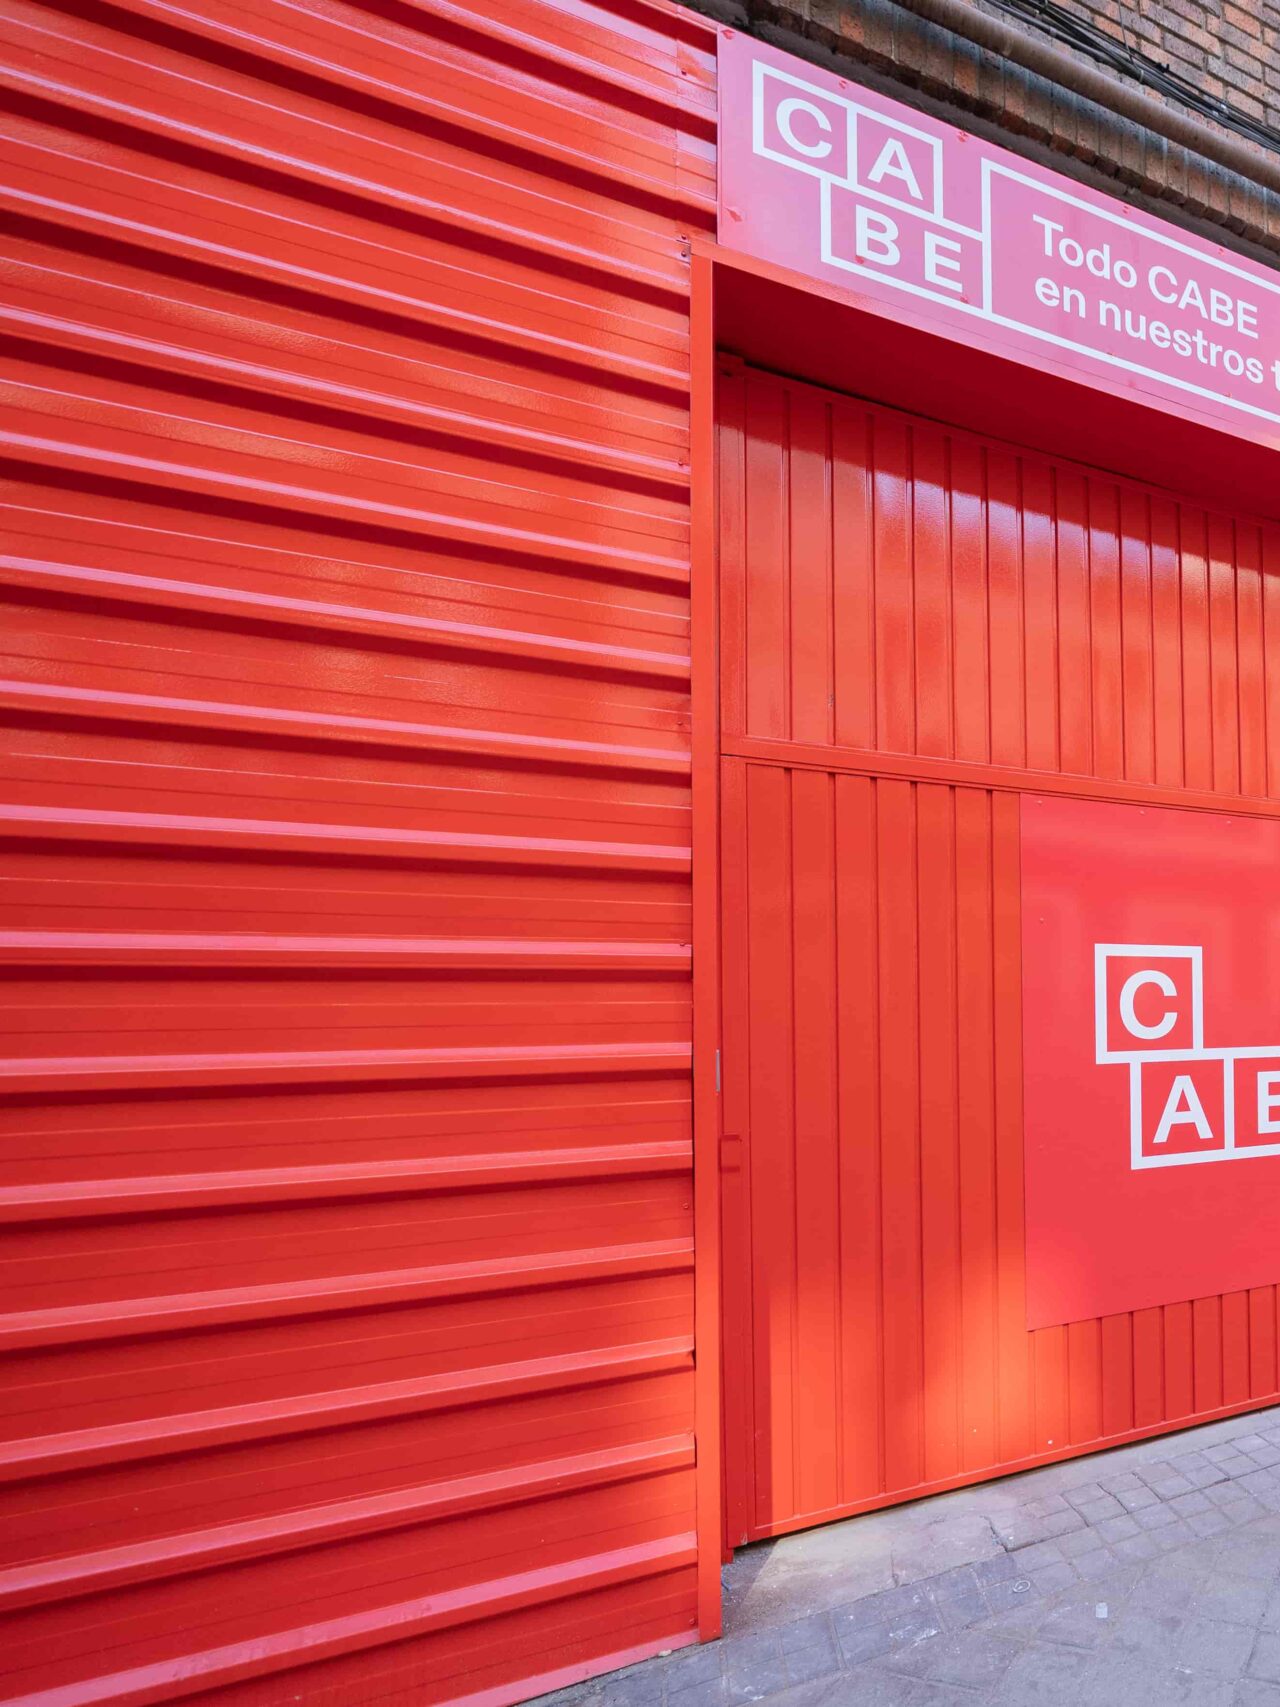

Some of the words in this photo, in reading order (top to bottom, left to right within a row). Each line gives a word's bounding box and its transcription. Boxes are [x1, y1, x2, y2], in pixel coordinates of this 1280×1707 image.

[1032, 214, 1138, 289] Todo
[1147, 265, 1260, 339] CABE
[1034, 276, 1086, 319] en
[1099, 298, 1264, 385] nuestros
